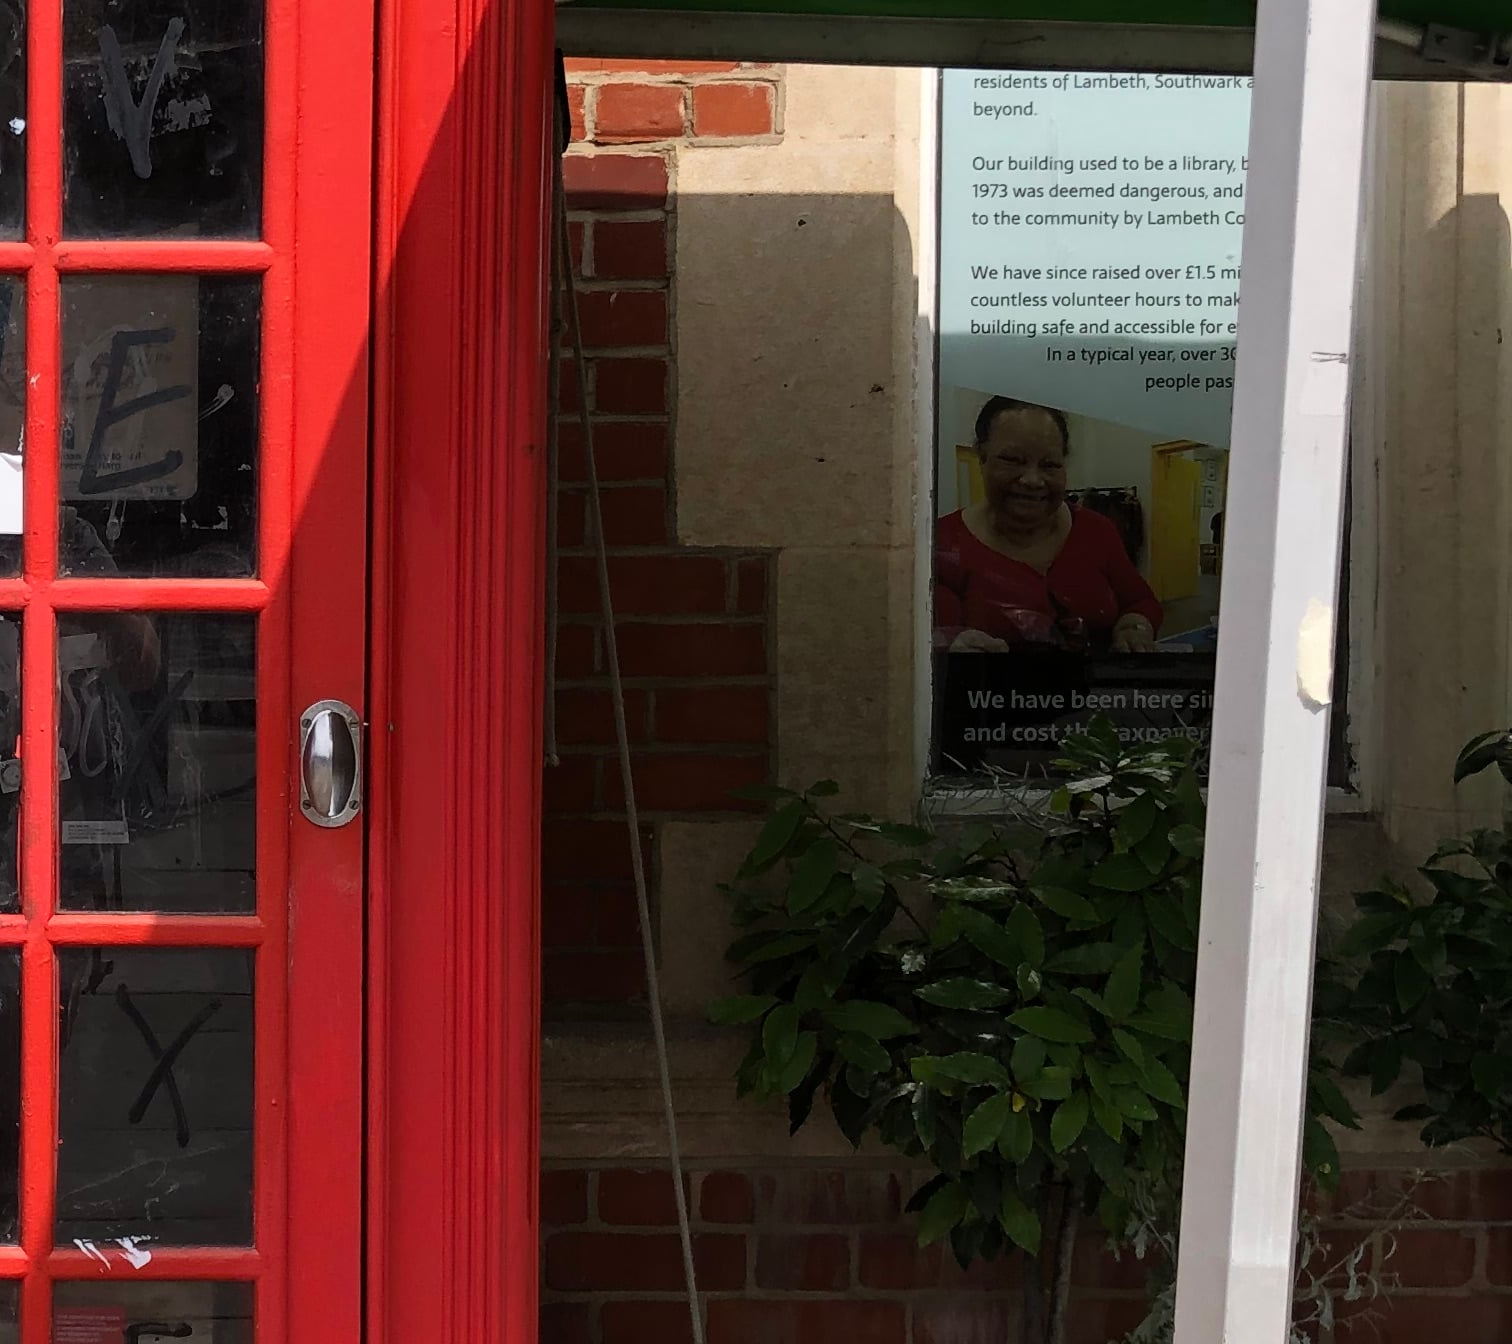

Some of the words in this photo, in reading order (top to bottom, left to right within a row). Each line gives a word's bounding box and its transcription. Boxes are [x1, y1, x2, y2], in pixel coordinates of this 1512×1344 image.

[974, 74, 1047, 89] residents
[1052, 74, 1069, 88] of
[1074, 74, 1150, 90] Lambeth,
[1155, 74, 1241, 89] Southwark
[973, 102, 1038, 119] beyond.
[972, 157, 1002, 171] Our
[1008, 156, 1074, 174] building
[1080, 157, 1117, 171] used
[1122, 158, 1139, 171] to
[1144, 157, 1163, 171] be
[1168, 160, 1177, 171] a
[1182, 156, 1237, 174] library,
[972, 184, 1007, 198] 1973
[1013, 187, 1044, 198] was
[1049, 184, 1114, 198] deemed
[1120, 184, 1208, 201] dangerous,
[1214, 184, 1243, 198] and
[972, 213, 988, 225] to
[994, 211, 1020, 225] the
[1026, 212, 1118, 228] community
[1124, 211, 1143, 228] by
[1148, 211, 1219, 225] Lambeth
[971, 266, 998, 279] We
[1003, 266, 1041, 279] have
[1046, 266, 1087, 279] since
[1092, 266, 1140, 279] raised
[1145, 269, 1180, 279] over
[1185, 266, 1215, 279] £1.5
[971, 293, 1047, 307] countless
[1052, 294, 1130, 307] volunteer
[1136, 294, 1180, 307] hours
[1185, 295, 1202, 307] to
[971, 320, 1036, 338] building
[1042, 320, 1074, 337] safe
[1079, 320, 1109, 334] and
[1114, 320, 1195, 334] accessible
[1200, 320, 1223, 337] for
[1047, 348, 1062, 361] In
[1067, 351, 1076, 361] a
[1081, 347, 1134, 364] typical
[1139, 351, 1176, 364] year,
[1181, 351, 1216, 361] over
[1146, 375, 1200, 392] people
[967, 690, 1004, 708] We
[1011, 690, 1064, 708] have
[1071, 690, 1126, 708] been
[1133, 690, 1183, 708] here
[964, 724, 1005, 742] and
[1012, 725, 1056, 742] cost
